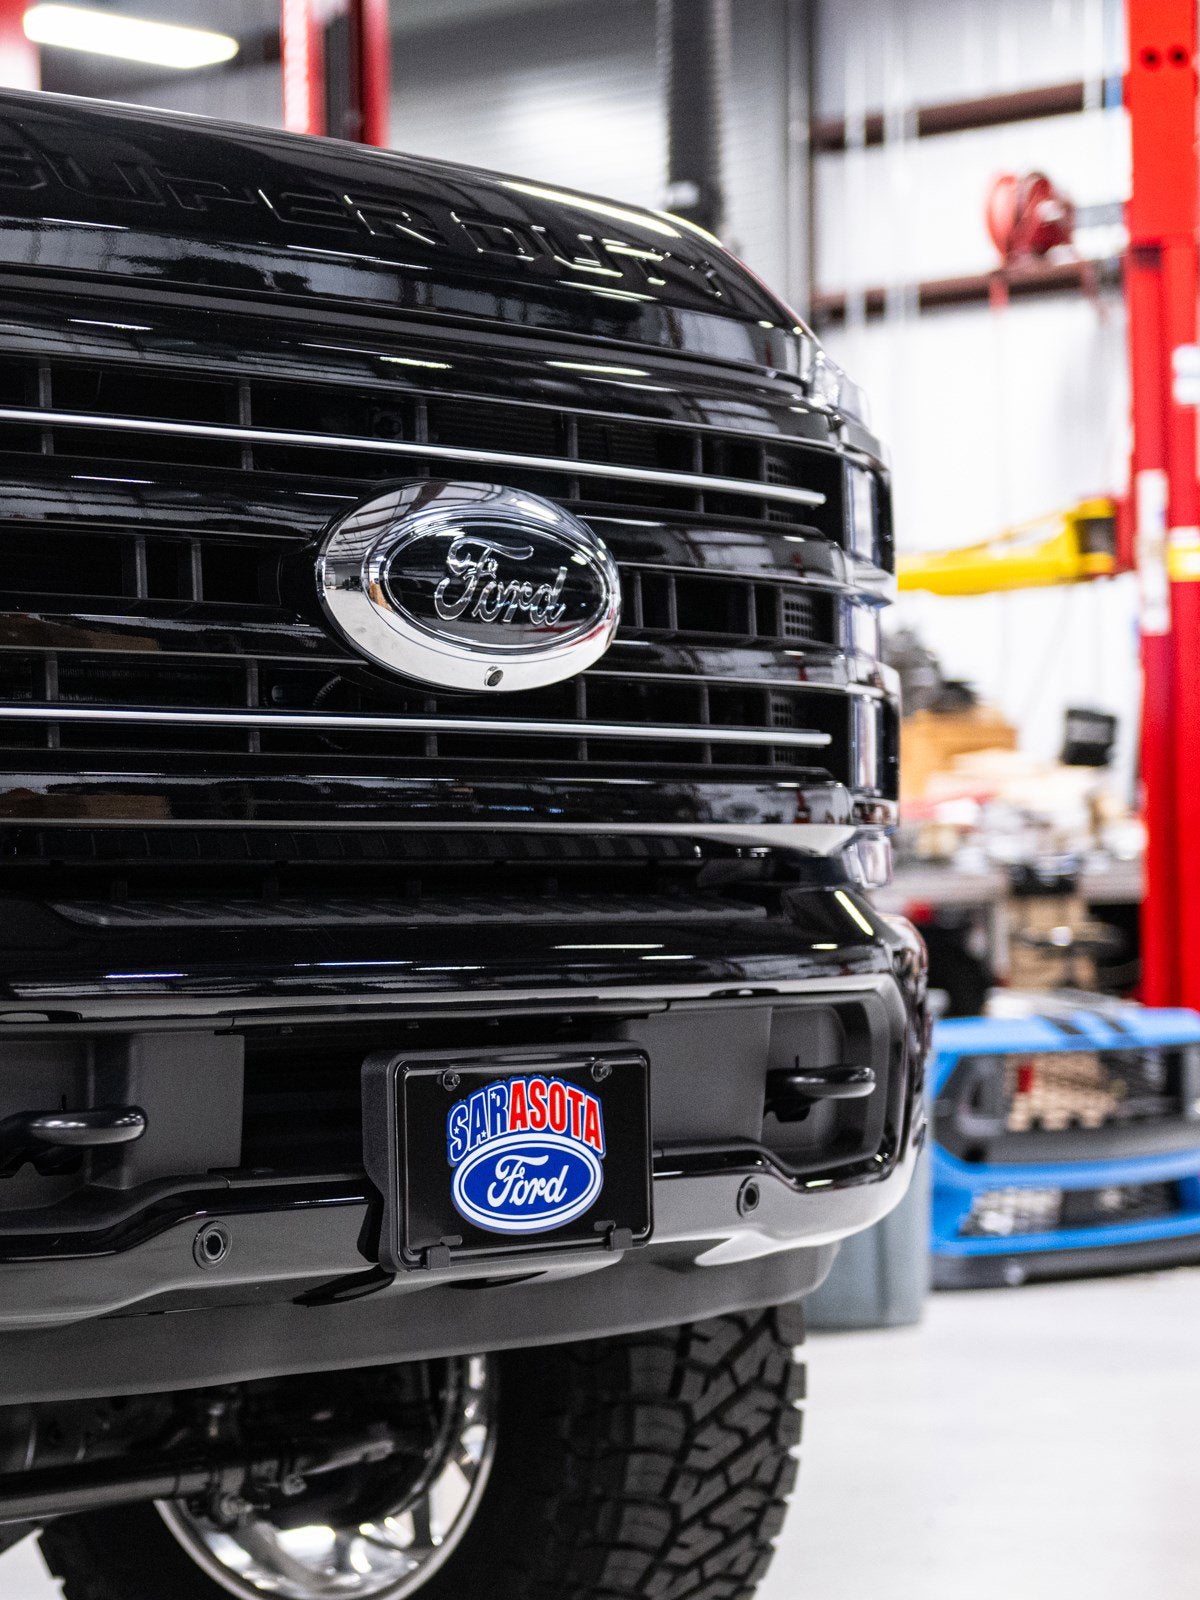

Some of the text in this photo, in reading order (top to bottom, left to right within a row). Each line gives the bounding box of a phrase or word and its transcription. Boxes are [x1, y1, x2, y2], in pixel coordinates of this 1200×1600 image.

[434, 536, 568, 627] Ford
[448, 1078, 604, 1162] SARASOTA
[487, 1154, 569, 1208] Ford
